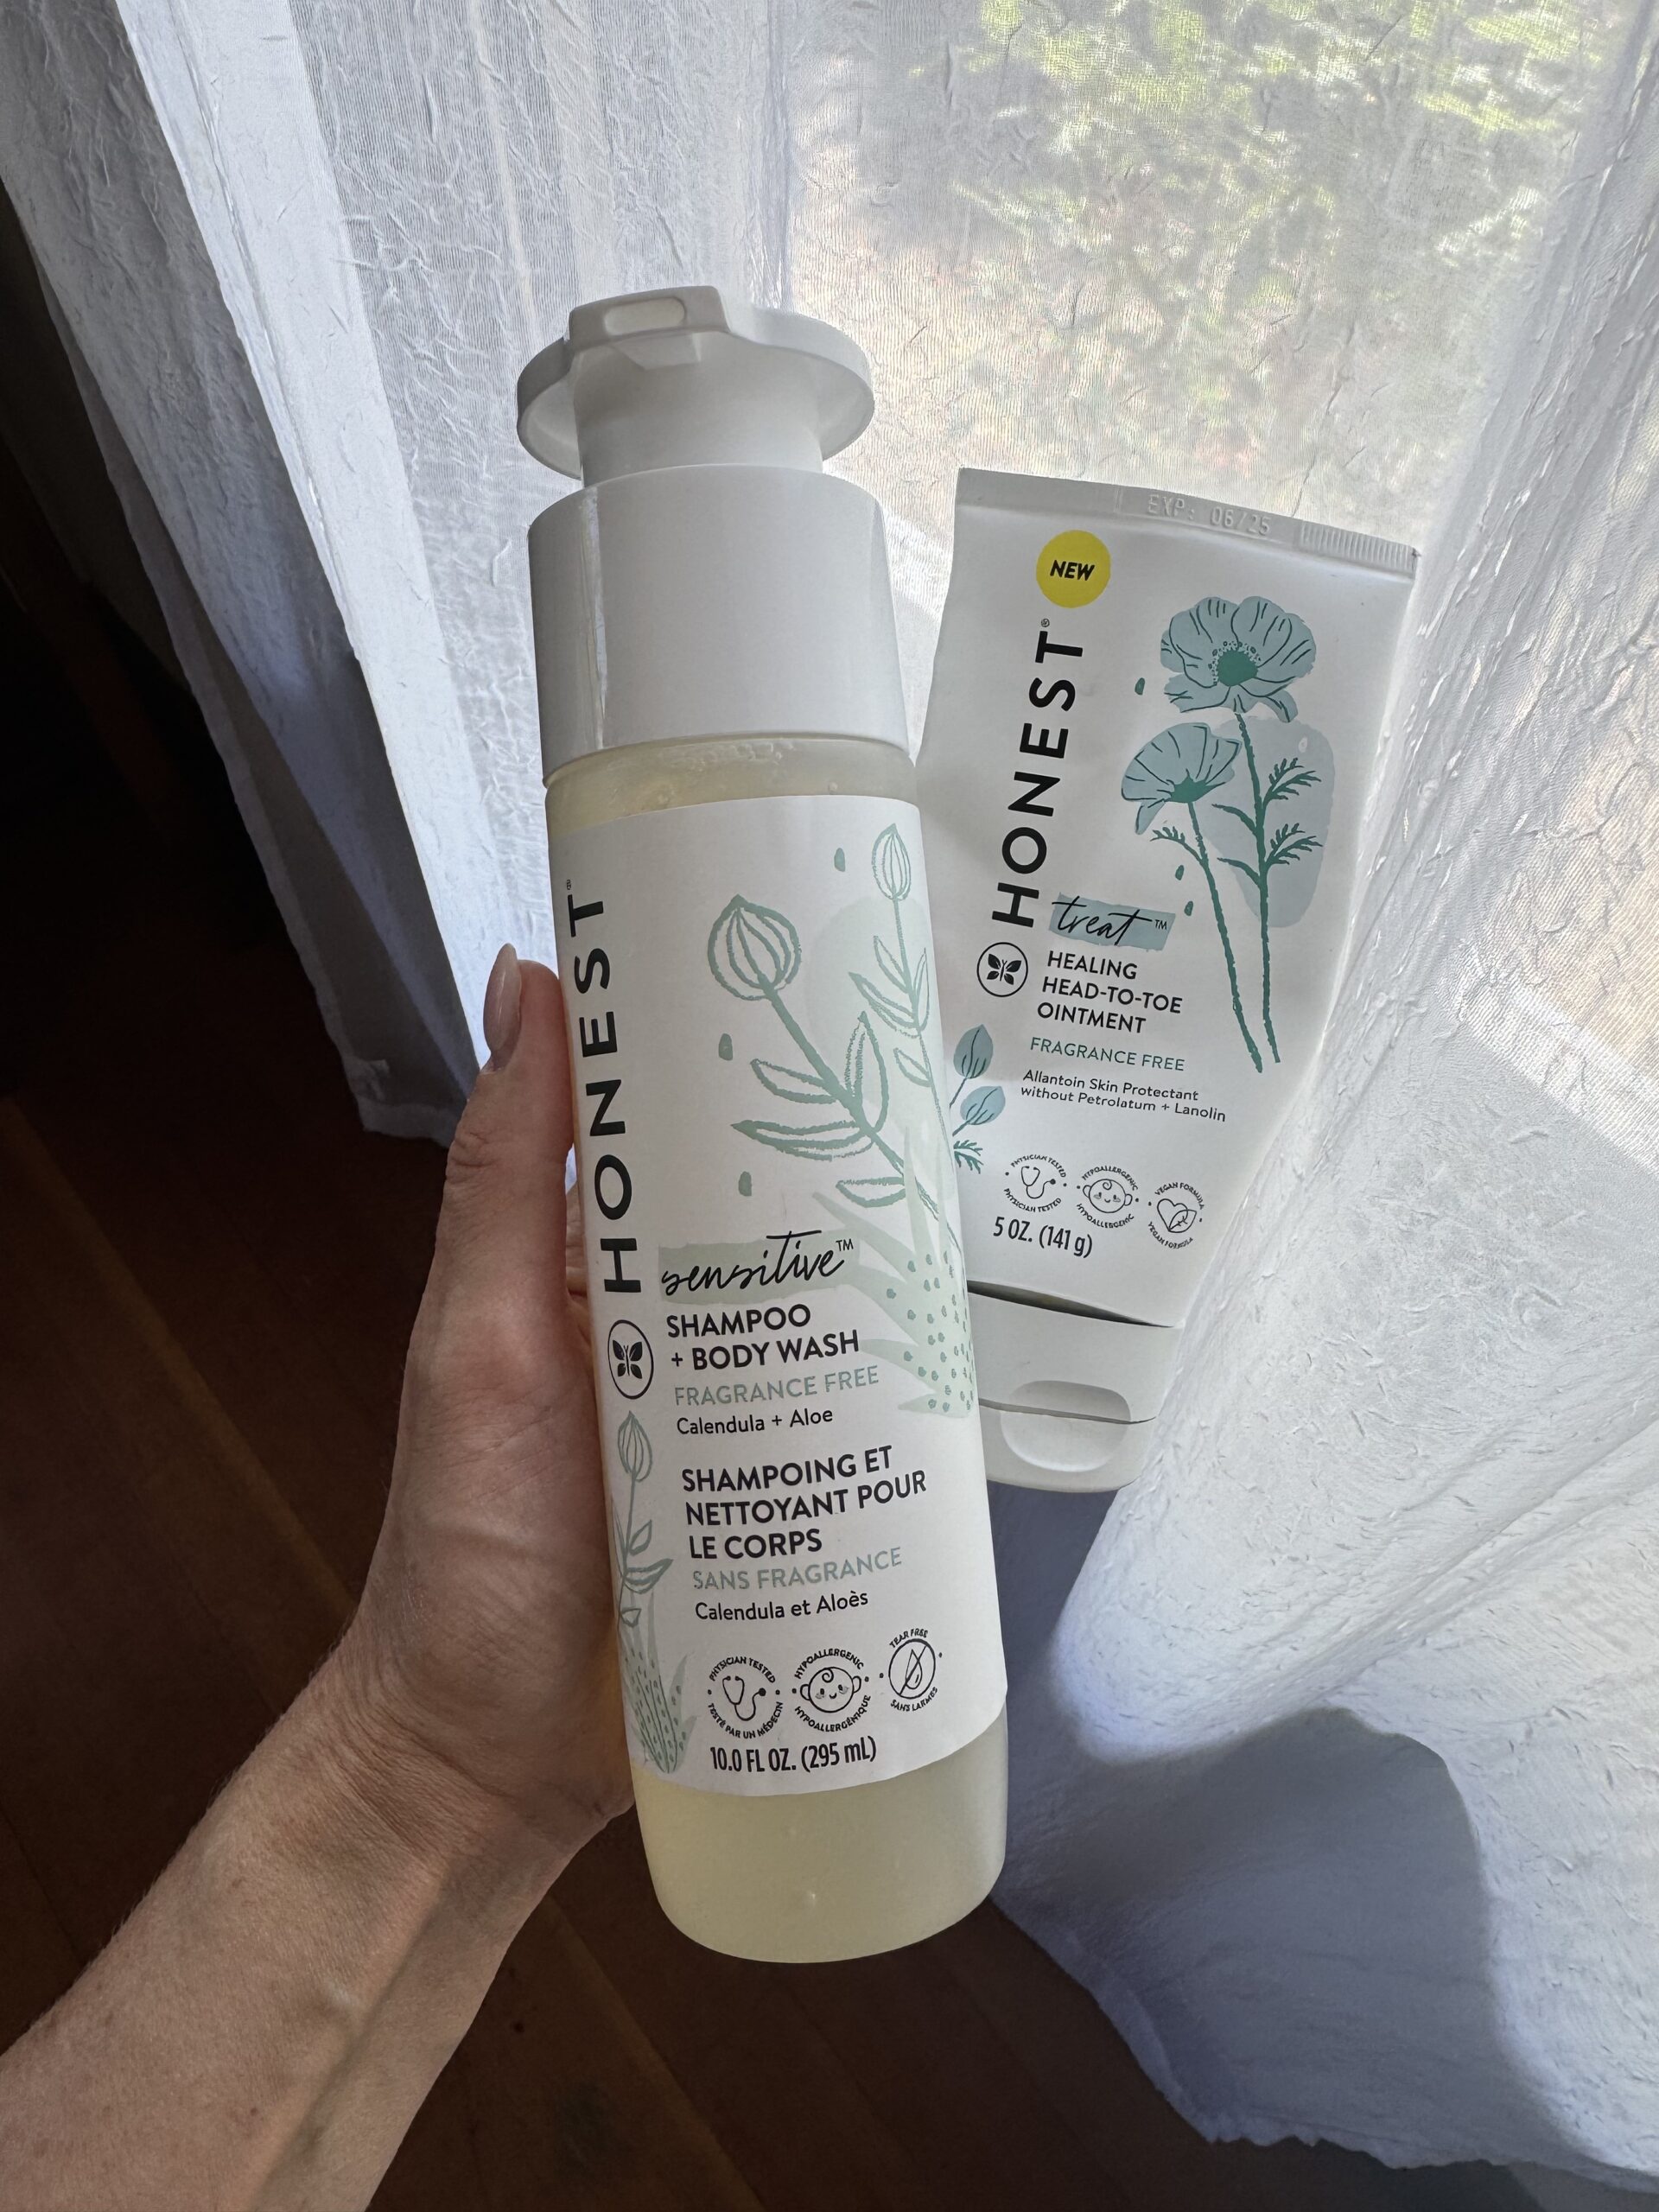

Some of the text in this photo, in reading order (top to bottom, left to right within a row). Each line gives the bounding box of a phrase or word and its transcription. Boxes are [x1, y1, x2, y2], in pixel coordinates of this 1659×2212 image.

[1049, 560, 1095, 582] NEW
[1047, 950, 1138, 980] HEALING
[1041, 976, 1182, 1014] HEAD-TO-TOE
[1037, 1002, 1146, 1033] OINTMENT
[1030, 1037, 1185, 1071] FRAGRANCE FREE
[1022, 1070, 1199, 1101] Allantoin Skin Protectant
[1020, 1086, 1074, 1102] without
[1077, 1093, 1156, 1111] Petrolatum
[1174, 1103, 1226, 1122] Lanolin
[1047, 1157, 1066, 1178] TESTED
[1154, 1182, 1179, 1196] VEGAN
[1038, 1198, 1062, 1212] TESTED
[993, 1217, 1003, 1237] 5
[1007, 1220, 1033, 1243] OZ.
[666, 1304, 811, 1338] SHAMPOO
[671, 1329, 860, 1370] + BODY WASH
[674, 1365, 880, 1406] FRAGRANCE FREE
[677, 1408, 833, 1435] Calendula + Aloe
[682, 1445, 893, 1492] SHAMPOING ET
[685, 1470, 927, 1527] NETTOYANT POUR
[689, 1529, 823, 1560] LE CORPS
[692, 1547, 902, 1590] SANS FRAGRANCE
[695, 1591, 868, 1621] Calendula et Aloès
[889, 1628, 929, 1649] TEAR FREE
[709, 1656, 776, 1683] PHYSICIAN TESTED
[793, 1648, 865, 1679] HYPOALLERGENIC
[890, 1686, 938, 1712] SANS LARMES
[725, 1725, 741, 1738] PAR
[743, 1731, 756, 1739] UN
[710, 1735, 877, 1773] 10.0 FL OZ. (295 mL)
